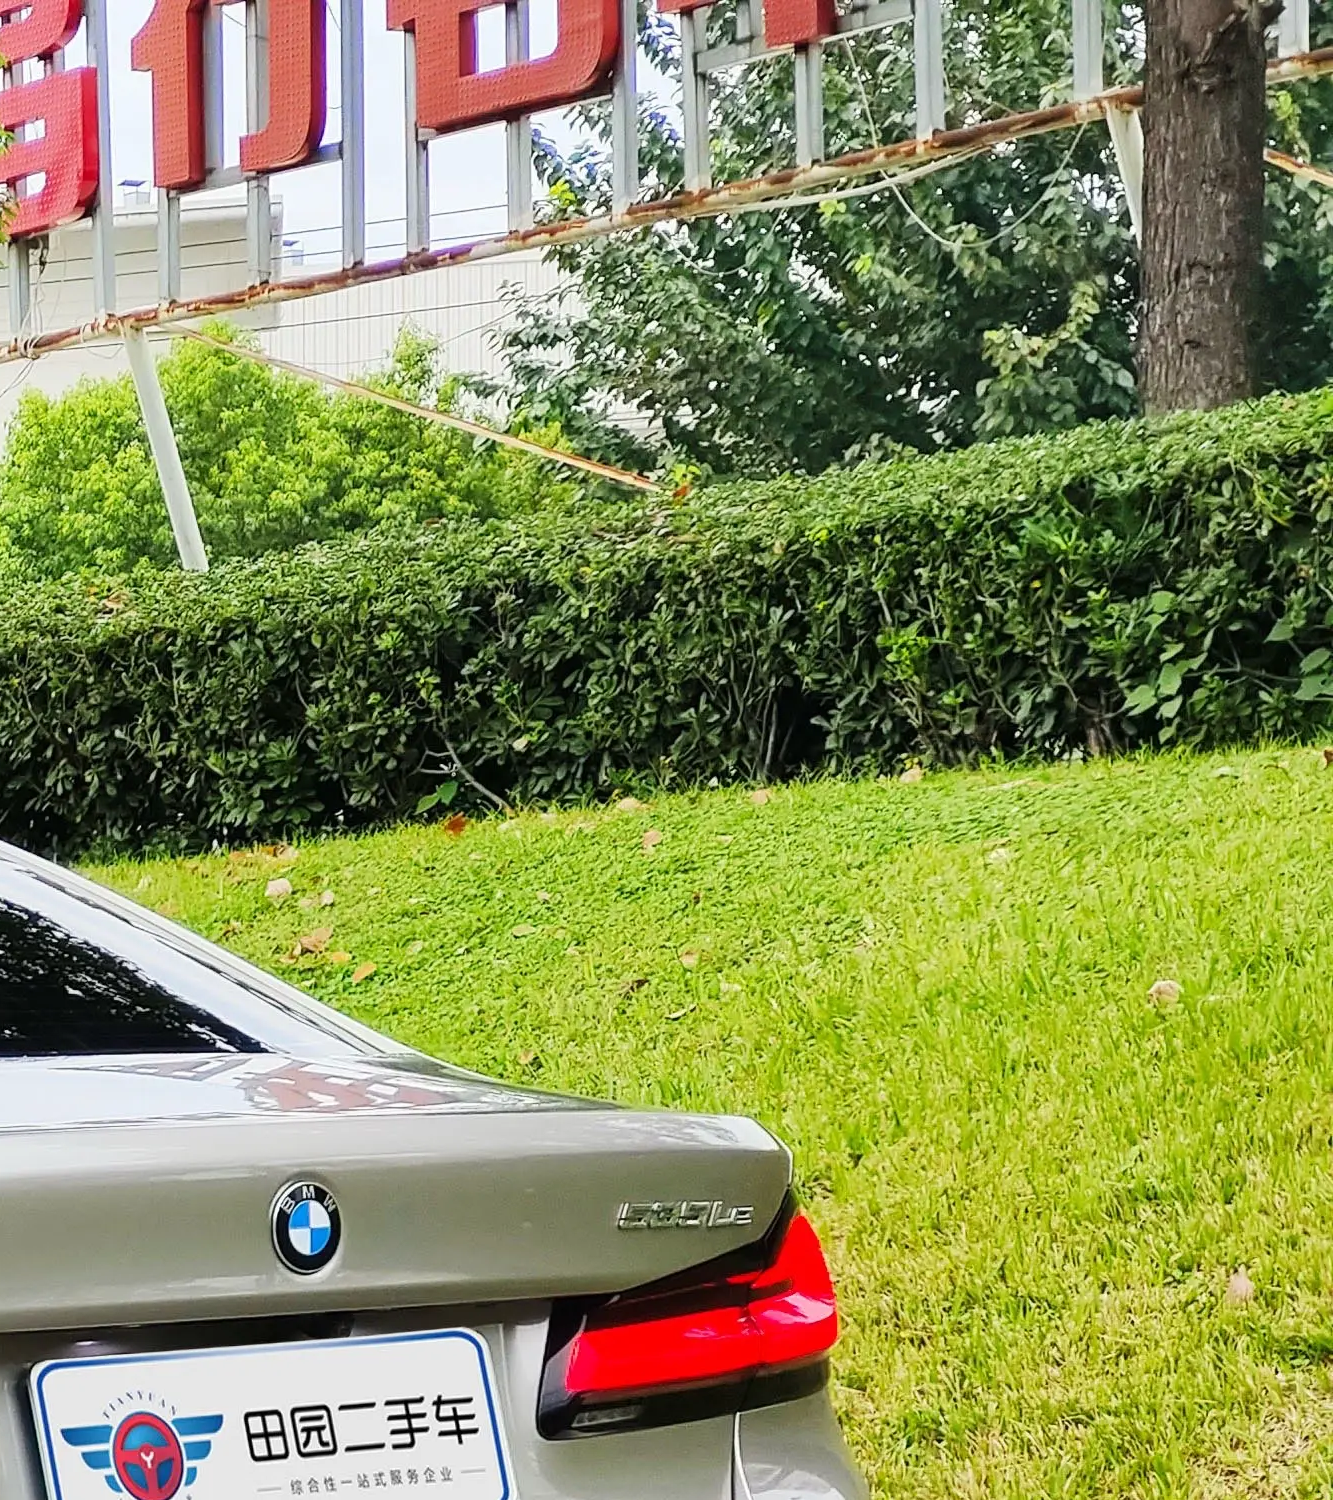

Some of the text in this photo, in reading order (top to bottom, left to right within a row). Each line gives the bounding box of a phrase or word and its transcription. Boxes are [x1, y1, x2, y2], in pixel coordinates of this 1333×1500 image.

[280, 1185, 338, 1215] BMW
[244, 1394, 480, 1462] 田园二手车
[290, 1466, 454, 1496] 综合性一站式服务企业
